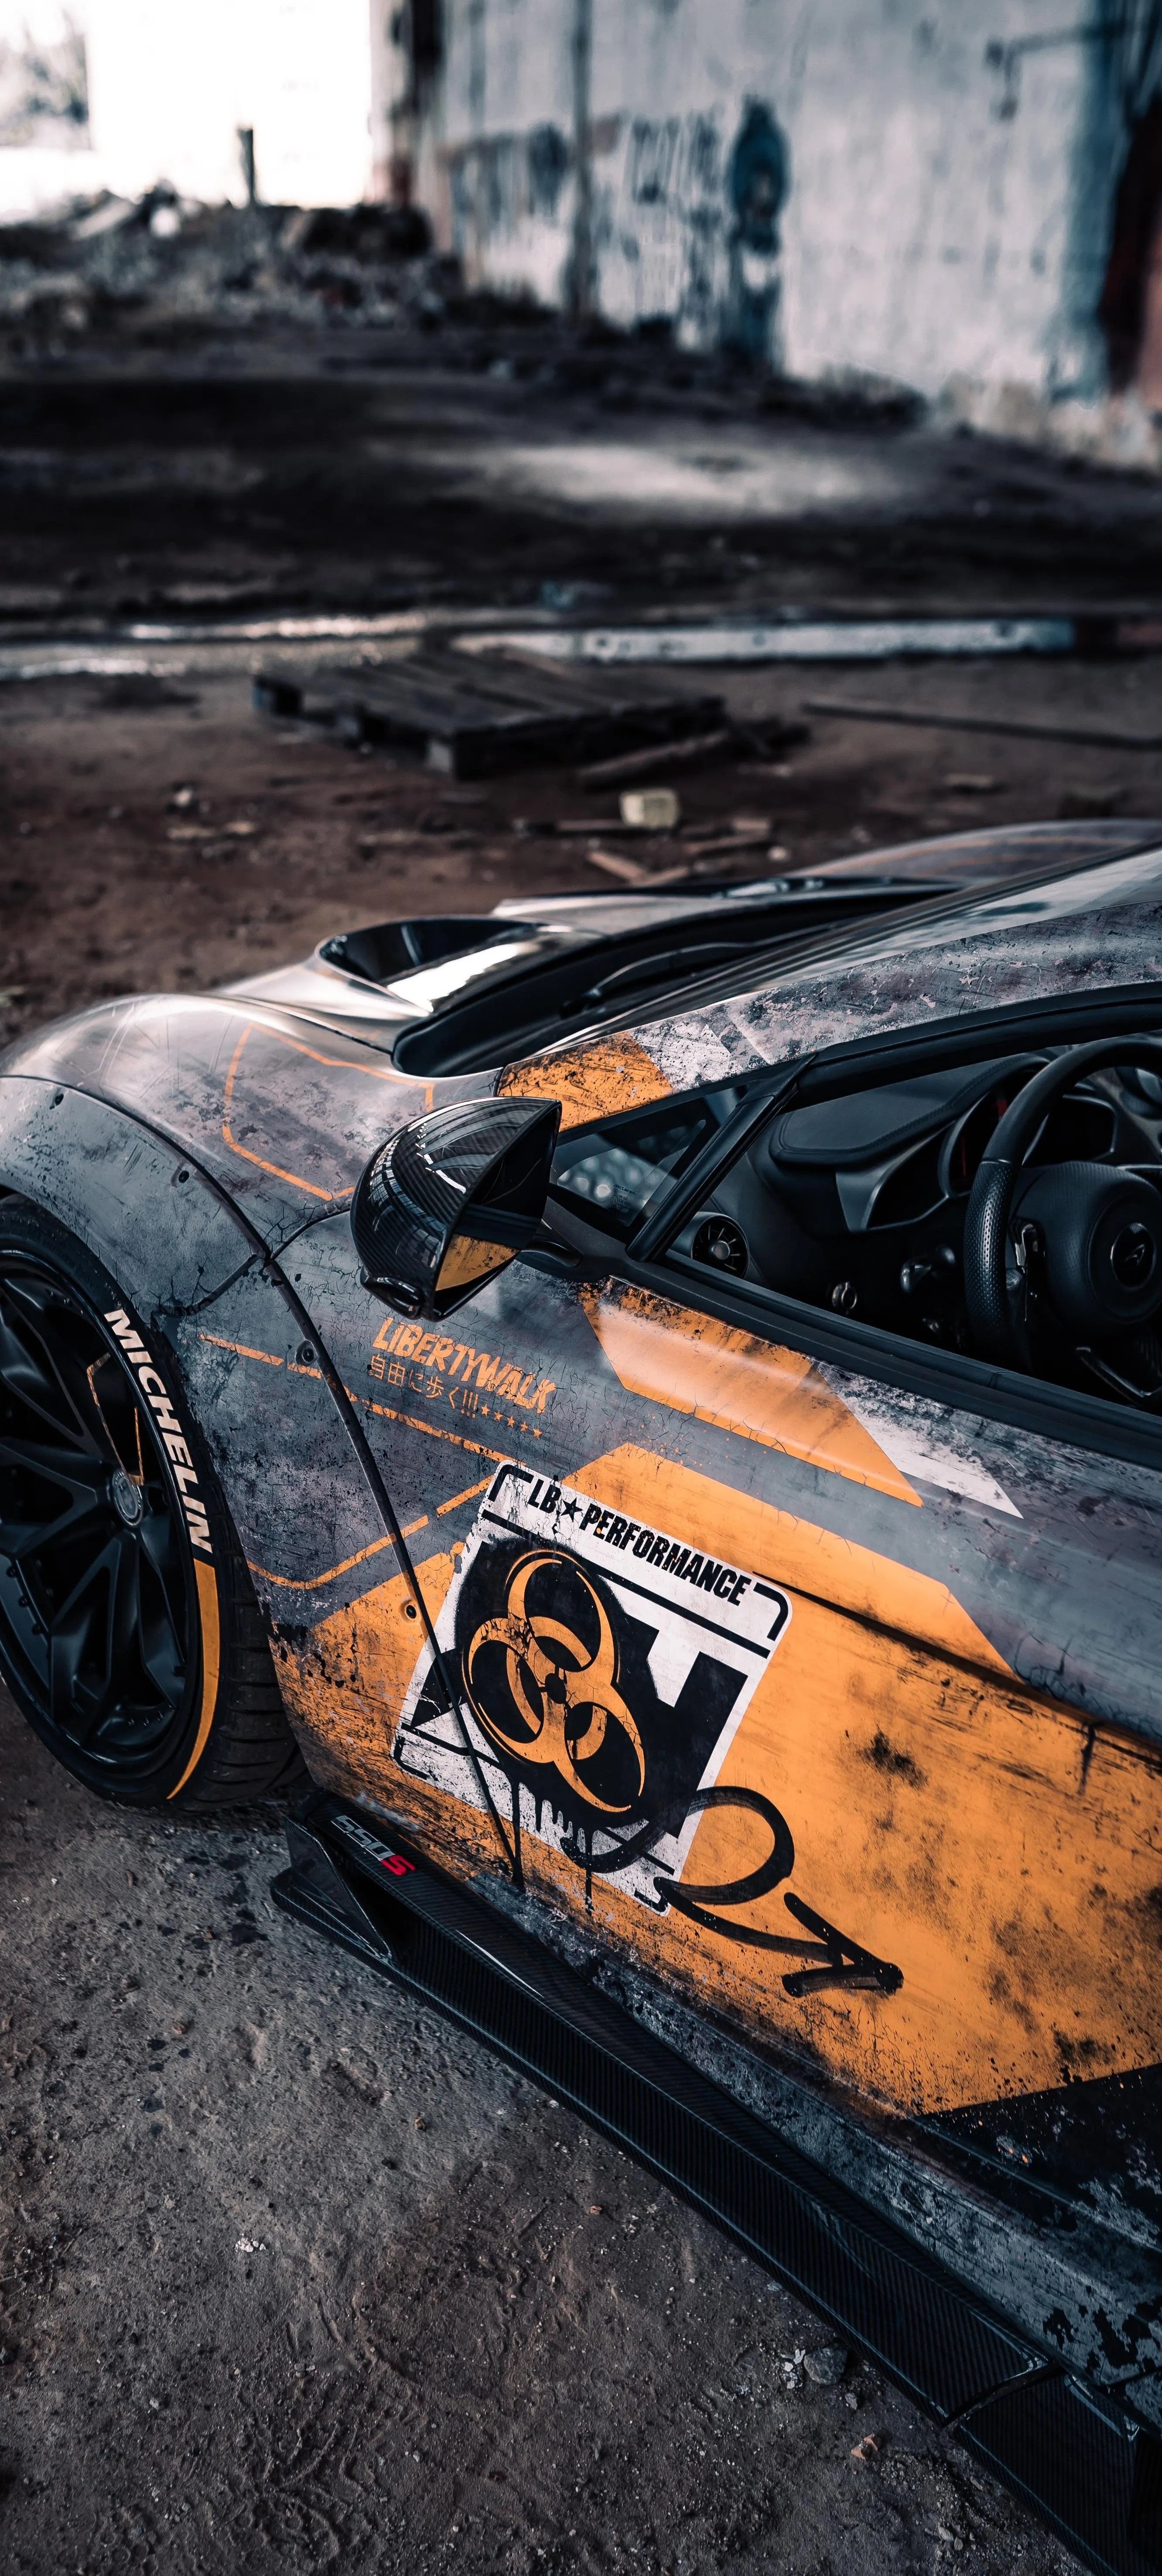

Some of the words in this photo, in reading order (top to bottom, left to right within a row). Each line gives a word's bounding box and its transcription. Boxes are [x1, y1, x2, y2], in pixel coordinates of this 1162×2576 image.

[373, 1317, 556, 1414] LIBERTYWALK
[104, 1309, 213, 1553] MICHELIN
[579, 1503, 752, 1606] PERFORMANCE
[330, 1815, 416, 1876] 650S
